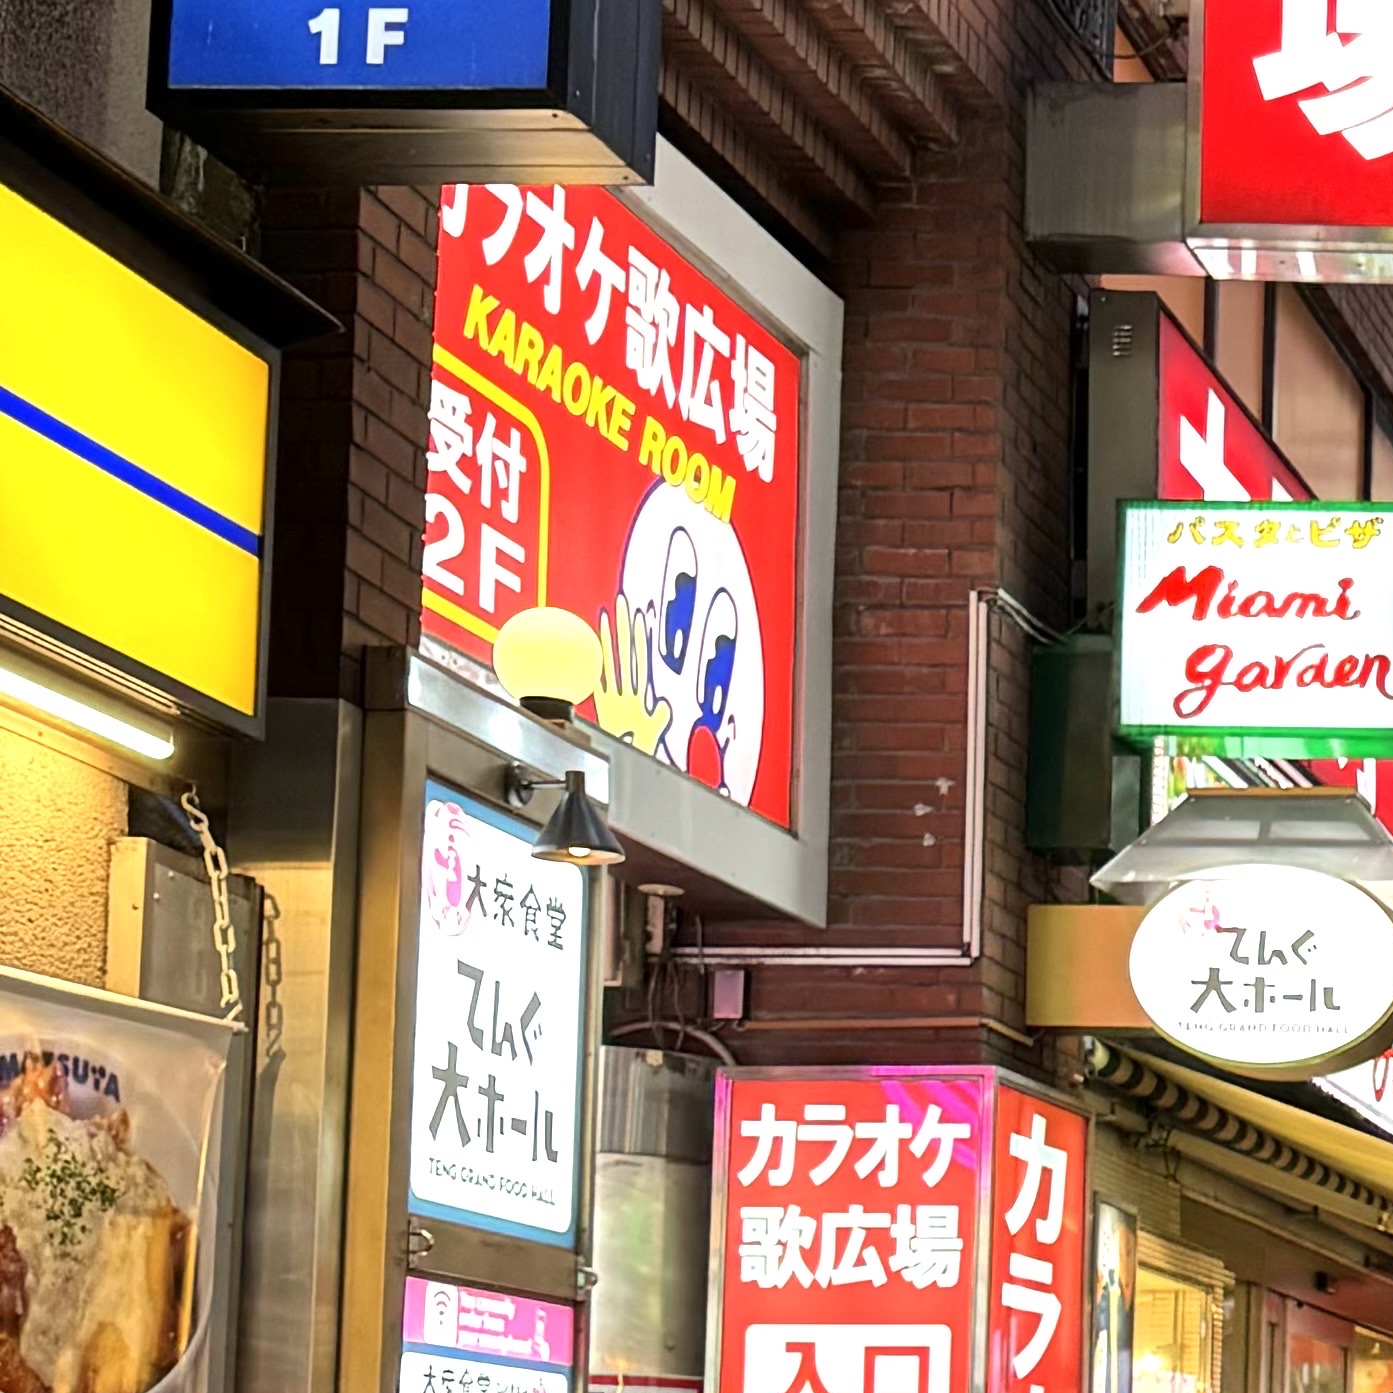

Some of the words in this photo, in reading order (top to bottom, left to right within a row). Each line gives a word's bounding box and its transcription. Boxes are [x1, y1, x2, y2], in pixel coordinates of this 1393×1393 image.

[309, 8, 408, 65] 1F
[463, 285, 632, 451] KARAOKE
[639, 421, 737, 525] ROOM
[426, 380, 528, 525] 受付
[423, 492, 526, 614] 2F
[1167, 516, 1384, 551] パスタとピザ
[1136, 565, 1360, 621] Miami
[1214, 926, 1318, 967] てんぐ
[457, 958, 543, 1066] てんぐ
[1190, 967, 1341, 1014] 大ホール
[429, 1041, 559, 1164] 大ホール
[738, 1104, 971, 1188] カラオケ
[739, 1204, 963, 1289] 歌広場
